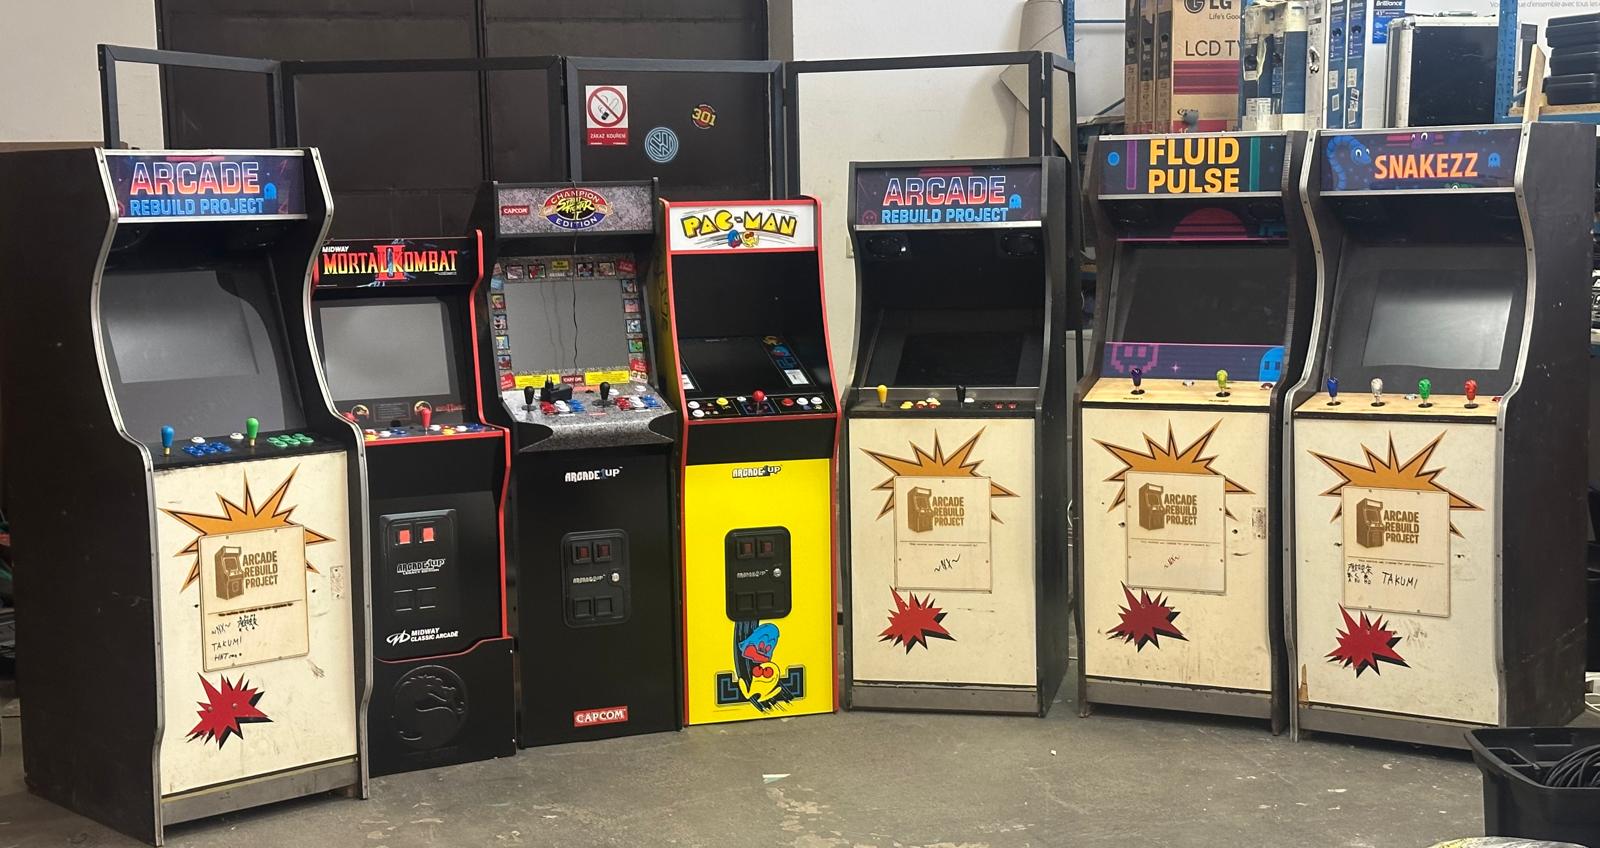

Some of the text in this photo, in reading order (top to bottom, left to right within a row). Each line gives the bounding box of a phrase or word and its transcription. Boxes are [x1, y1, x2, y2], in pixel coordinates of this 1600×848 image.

[1209, 0, 1232, 10] LG
[1208, 12, 1225, 20] Life's
[1185, 40, 1221, 57] LCD
[691, 107, 717, 127] 301
[1149, 137, 1240, 166] FLUID
[1374, 152, 1479, 180] SNAKEZZ
[130, 161, 261, 196] ARCADE
[1148, 167, 1240, 194] PULSE
[551, 190, 600, 204] CHAMPION
[882, 175, 1006, 206] ARCADE
[130, 197, 265, 216] REBUILD PROJECT
[503, 207, 529, 215] CAPCOM
[556, 216, 598, 228] EDITION
[881, 207, 1009, 224] REBUILD PROJECT
[680, 209, 798, 239] PAC-MAN
[322, 250, 458, 275] MORTAL KOMBAT
[932, 496, 965, 507] ARCADE
[1163, 493, 1198, 506] ARCADE
[933, 507, 965, 517] REBUILD
[1164, 504, 1198, 516] REBUILD
[1383, 510, 1420, 523] ARCADE
[934, 517, 965, 527] PROJECT
[1165, 514, 1198, 526] PROJECT
[1384, 521, 1420, 534] REBUILD
[1385, 532, 1420, 544] PROJECT
[242, 551, 278, 566] ARCADE
[244, 563, 278, 578] REBUILD
[245, 575, 279, 589] PROJECT
[1381, 571, 1418, 590] TAKUMI
[411, 627, 440, 637] MIDWAY
[411, 630, 459, 642] CLASSIC ARCADE
[211, 636, 242, 652] TAKUMI
[576, 709, 625, 723] CAPCOM
